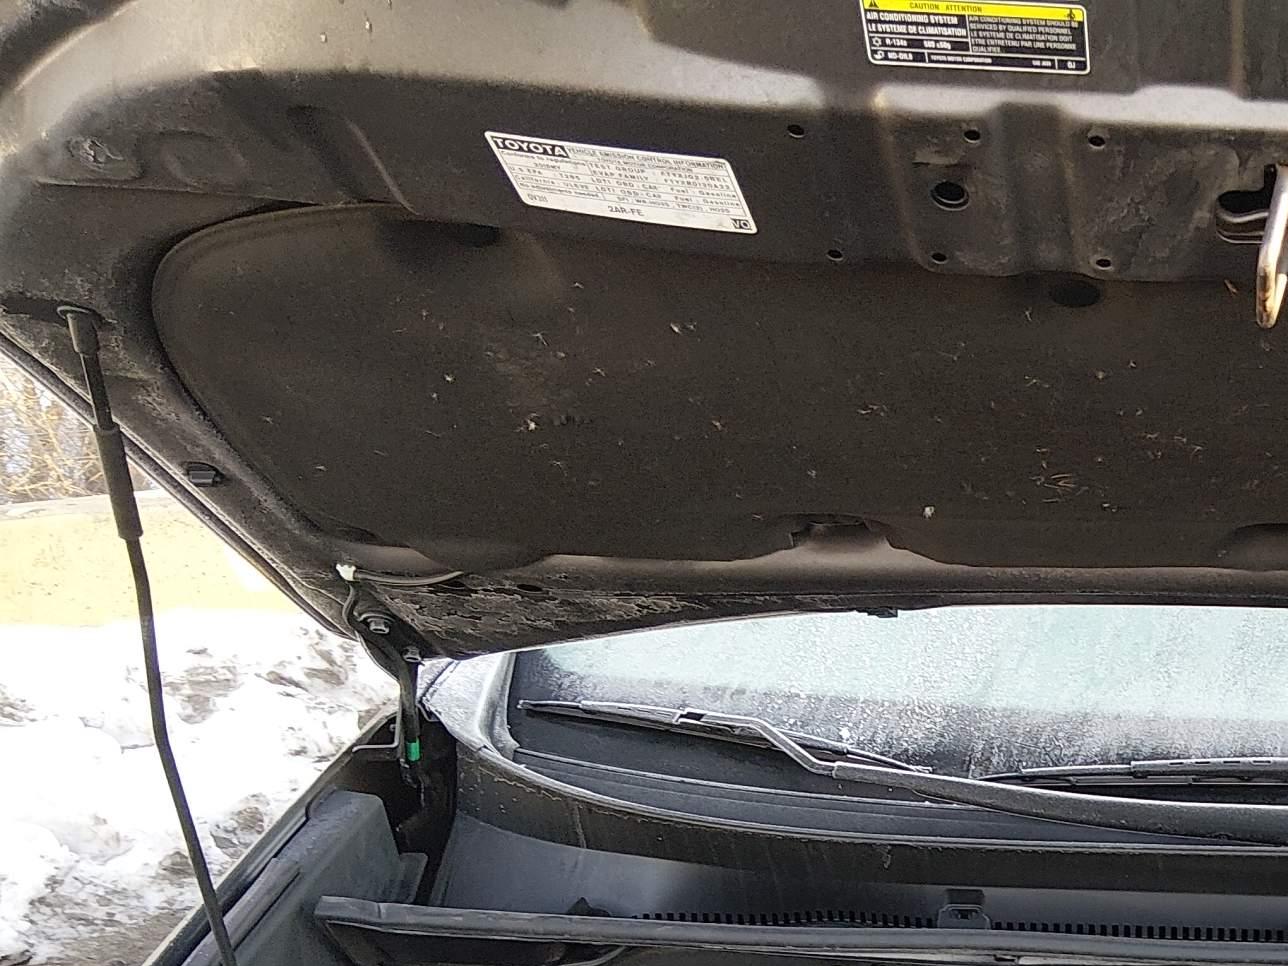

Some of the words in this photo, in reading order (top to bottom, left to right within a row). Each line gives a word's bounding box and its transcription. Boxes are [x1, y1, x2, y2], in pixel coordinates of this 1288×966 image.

[865, 10, 878, 19] AIR
[878, 11, 928, 23] CONDITIONING
[929, 14, 958, 24] SYSTEM
[1021, 18, 1046, 26] SYSTEM
[867, 22, 876, 31] LE
[907, 25, 917, 34] DE
[969, 22, 997, 30] SERVICED
[1007, 24, 1037, 33] QUALIFIED
[1037, 26, 1072, 35] PERSONNEL
[1005, 31, 1013, 39] DE
[492, 137, 568, 157] TOYOTA
[608, 205, 645, 217] 2AR-FE
